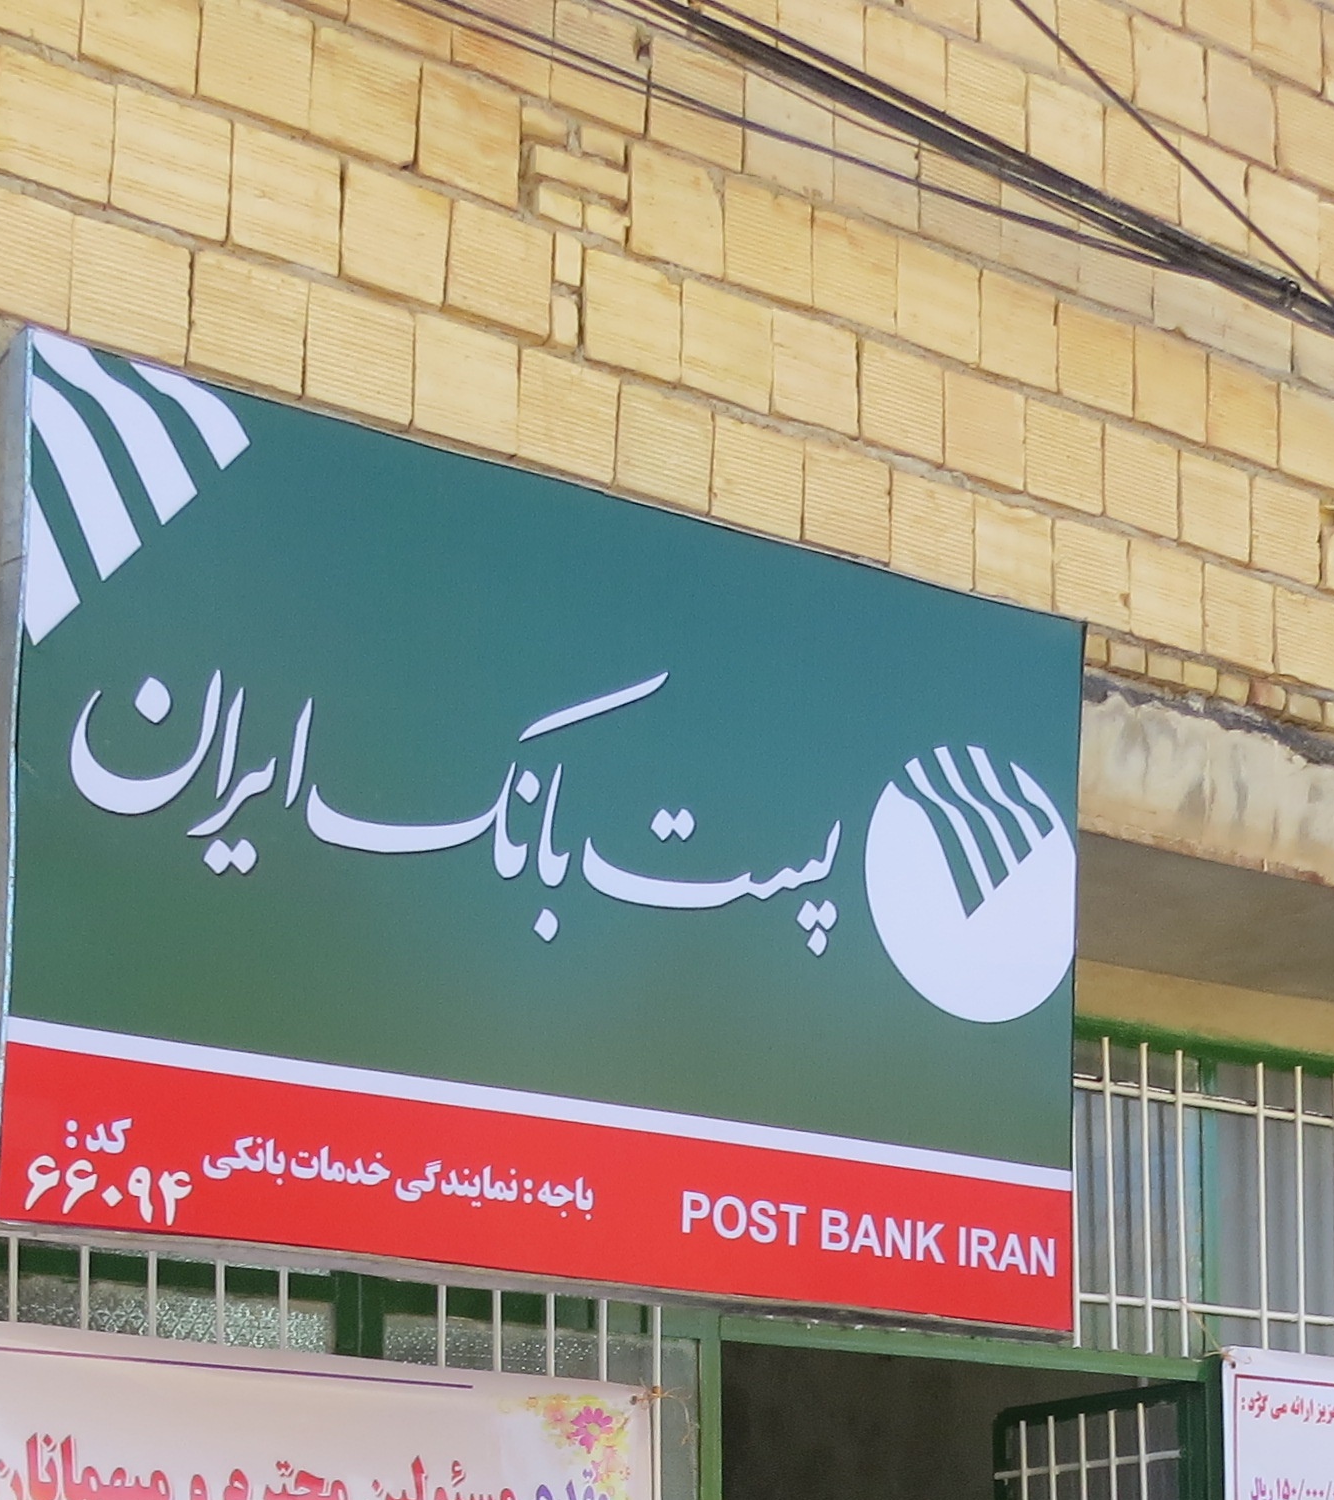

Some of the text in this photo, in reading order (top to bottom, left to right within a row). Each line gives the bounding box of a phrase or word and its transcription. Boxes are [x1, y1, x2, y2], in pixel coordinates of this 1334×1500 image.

[70, 668, 841, 956] پست بانک ایران
[202, 1137, 285, 1186] بانکی
[290, 1145, 391, 1186] خدمات
[395, 1160, 518, 1207] نمایندگی
[24, 1154, 193, 1225] ۶۶۰۹۴
[681, 1190, 1055, 1277] POST BANK IRAN
[1270, 1403, 1287, 1420] می
